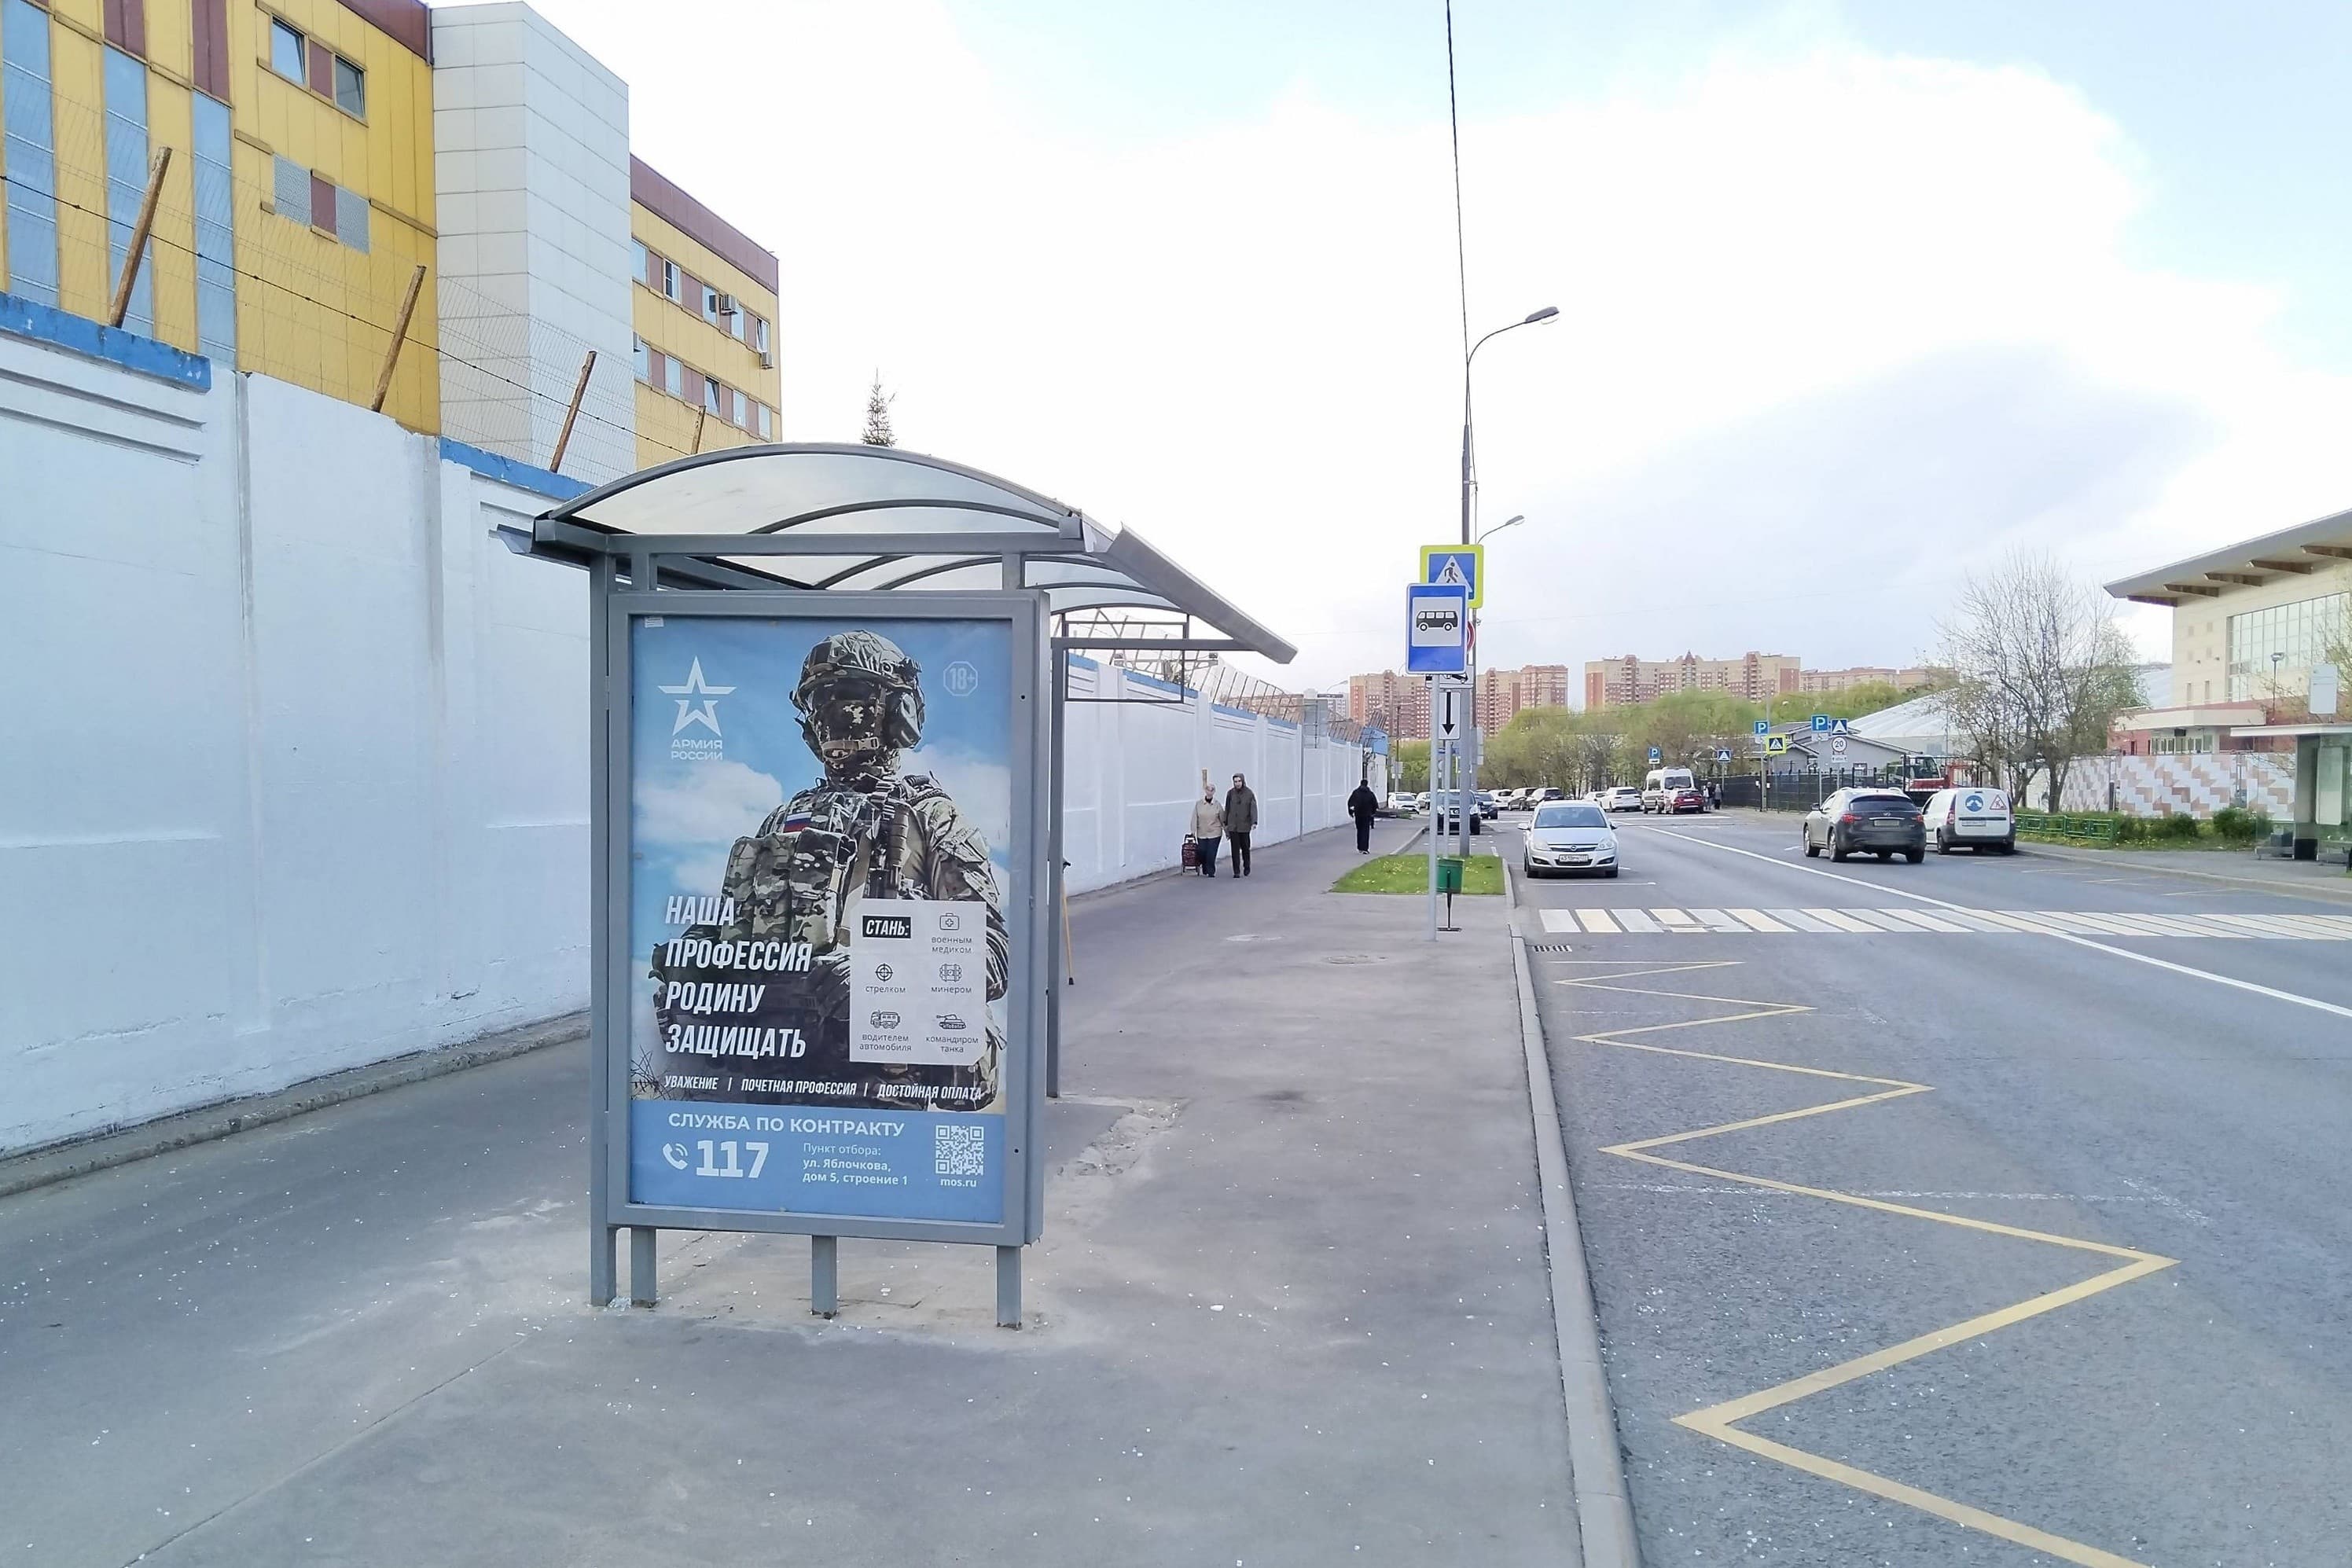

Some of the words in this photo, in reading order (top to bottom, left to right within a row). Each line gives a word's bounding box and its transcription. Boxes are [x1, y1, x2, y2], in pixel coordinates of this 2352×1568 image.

[950, 667, 976, 690] 18+
[671, 739, 723, 750] АРМИЯ
[671, 751, 723, 760] РОССИИ
[665, 895, 735, 927] НАША
[865, 919, 910, 936] СТАНЬ:
[665, 938, 813, 972] ПРОФЕССИЯ
[931, 946, 972, 955] медиком
[865, 986, 906, 995] стрелком
[931, 986, 972, 995] минером
[665, 981, 766, 1015] РОДИНУ
[665, 1023, 807, 1059] ЗАЩИЩАТЬ
[862, 1034, 910, 1042] водителем
[925, 1036, 979, 1045] командиром
[859, 1042, 912, 1052] автомобиля
[664, 1075, 719, 1091] УВАЖЕНИЕ
[741, 1078, 794, 1093] ПОЧЕТНАЯ
[795, 1080, 857, 1096] ПРОФЕССИЯ
[876, 1082, 939, 1099] ДОСТОЙНАЯ
[940, 1086, 983, 1100] ОПЛАТА
[668, 1113, 750, 1131] СЛУЖБА
[756, 1117, 785, 1133] ПО
[790, 1118, 905, 1137] КОНТРАКТУ
[803, 1143, 836, 1156] Пункт
[839, 1144, 882, 1157] отбора:
[696, 1140, 770, 1179] 117
[803, 1159, 820, 1170] ул.
[823, 1159, 891, 1172] Яблочкова,
[803, 1173, 826, 1183] дом
[829, 1172, 840, 1184] 5,
[843, 1173, 899, 1184] строение
[902, 1175, 908, 1185] 1
[940, 1177, 977, 1188] mos.ru
